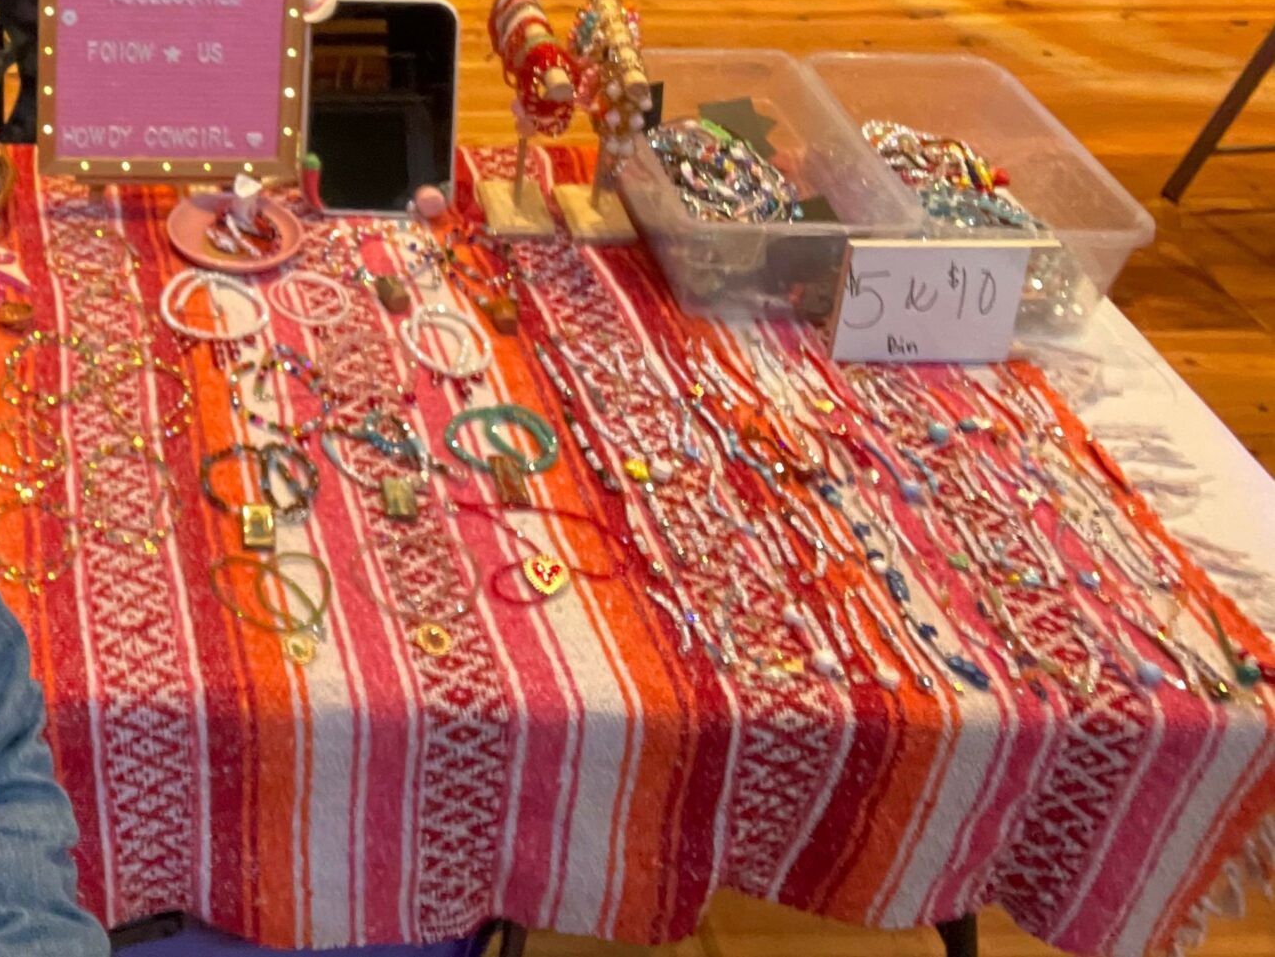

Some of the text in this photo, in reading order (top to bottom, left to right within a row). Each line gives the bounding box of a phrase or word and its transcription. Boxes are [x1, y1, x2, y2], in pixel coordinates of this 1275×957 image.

[197, 41, 223, 64] US
[62, 125, 235, 149] HOWDY COWGIRL
